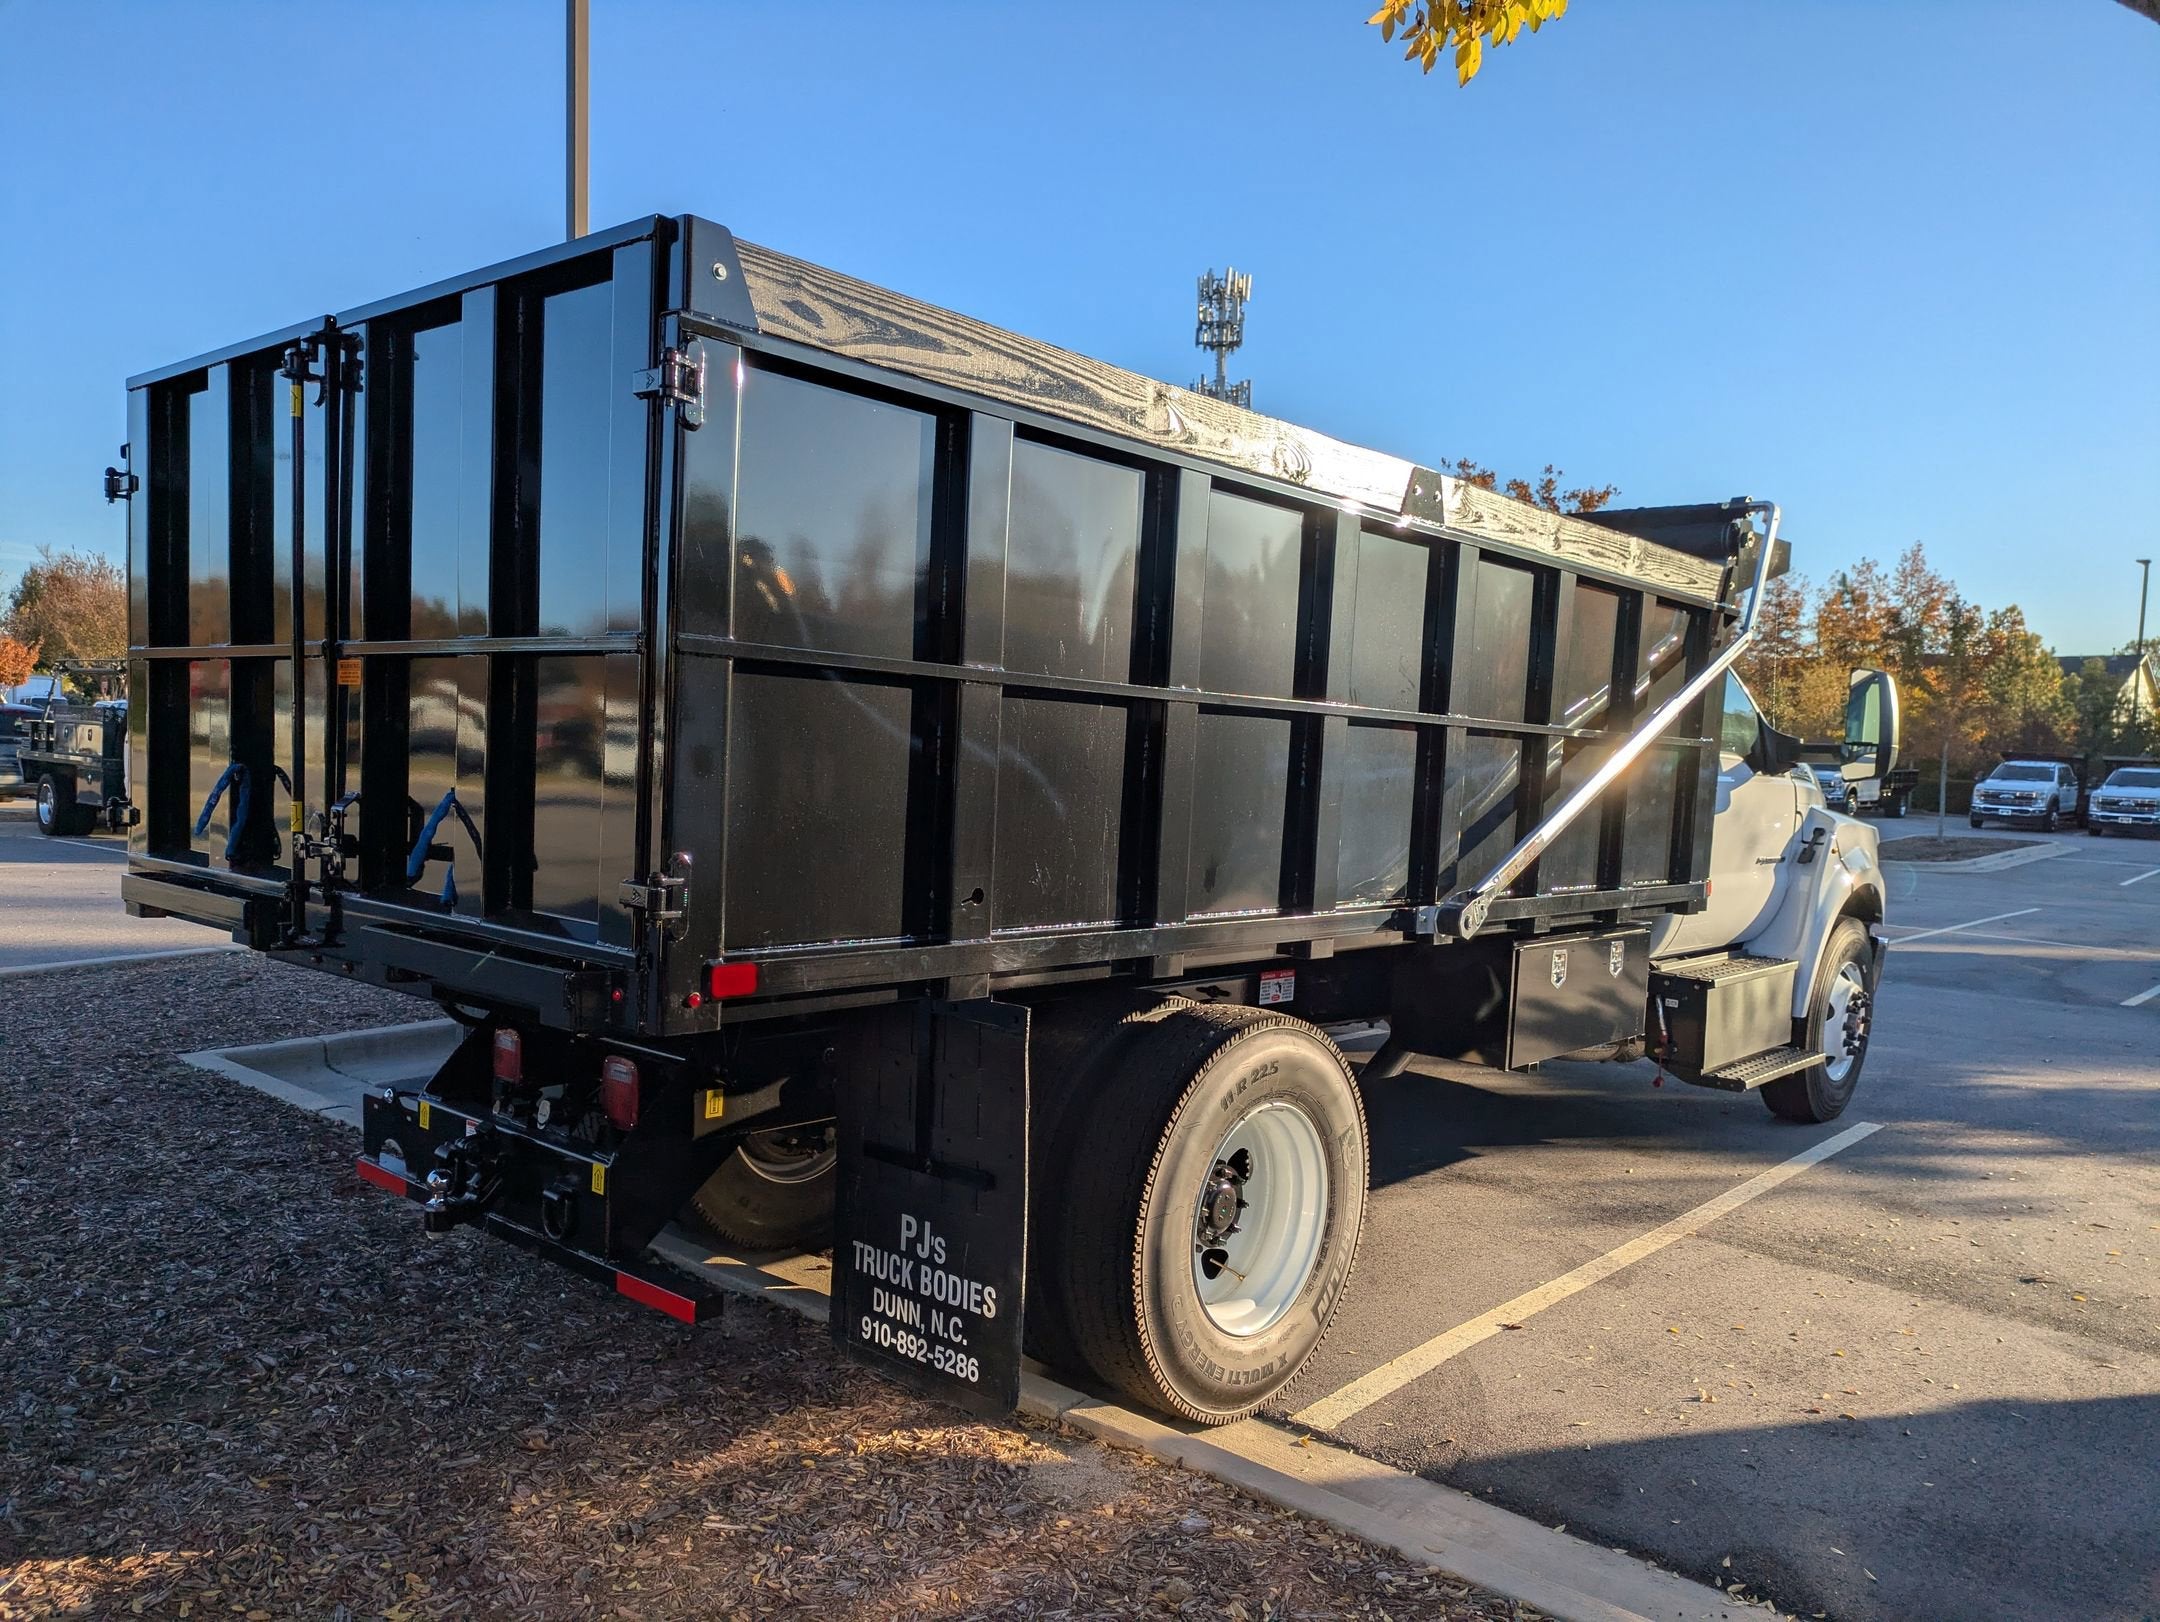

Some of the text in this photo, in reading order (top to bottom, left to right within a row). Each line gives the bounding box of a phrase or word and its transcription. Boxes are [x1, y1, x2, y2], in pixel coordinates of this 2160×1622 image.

[1316, 1170, 1358, 1321] MICHELIN
[852, 1240, 996, 1319] TRUCK BODIES
[861, 1315, 979, 1383] 910-892-5286
[873, 1287, 968, 1346] DUNN, N.C.
[1175, 1319, 1226, 1384] ENERGY
[1226, 1361, 1275, 1387] MULTI
[1277, 1351, 1289, 1370] X
